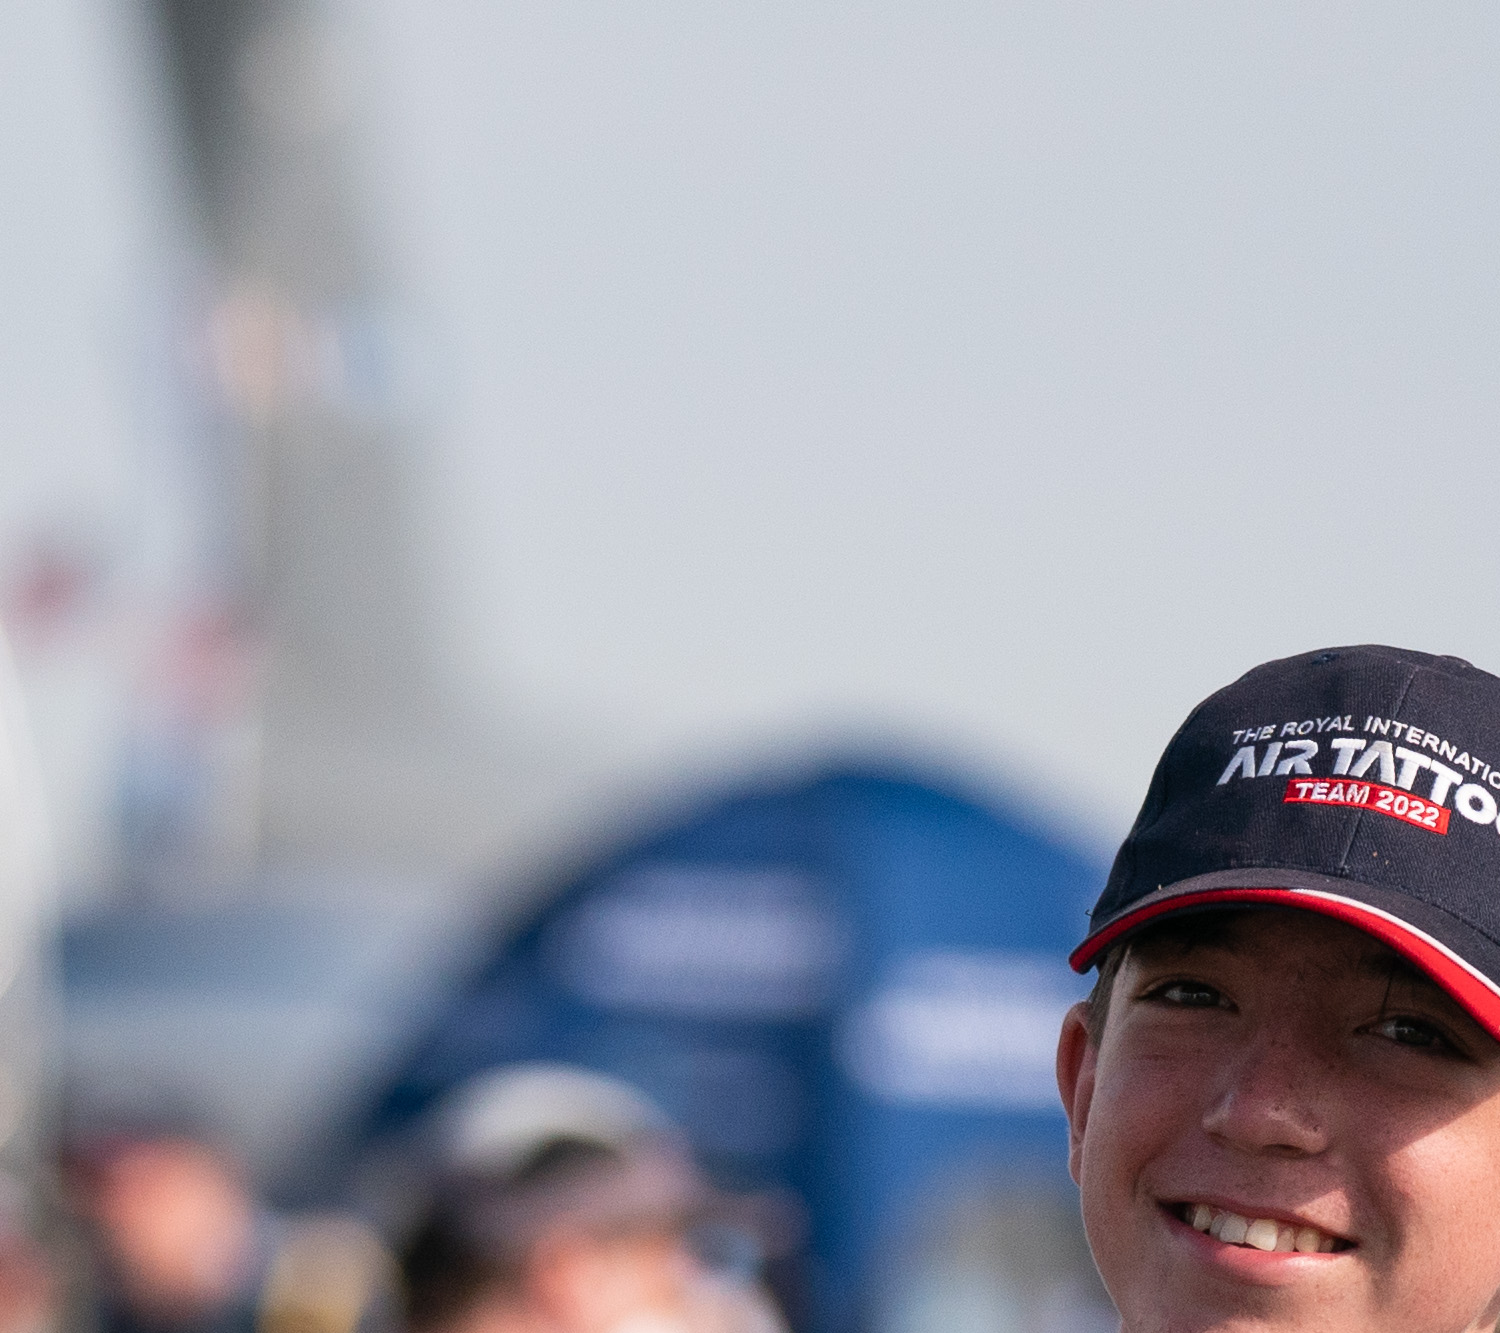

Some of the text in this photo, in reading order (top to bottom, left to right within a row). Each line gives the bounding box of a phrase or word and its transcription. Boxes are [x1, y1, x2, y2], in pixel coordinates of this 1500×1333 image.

[1232, 724, 1277, 745] THE
[1280, 714, 1356, 738] ROYAL
[1216, 739, 1319, 787] AIR
[1295, 782, 1441, 828] TEAM 2022
